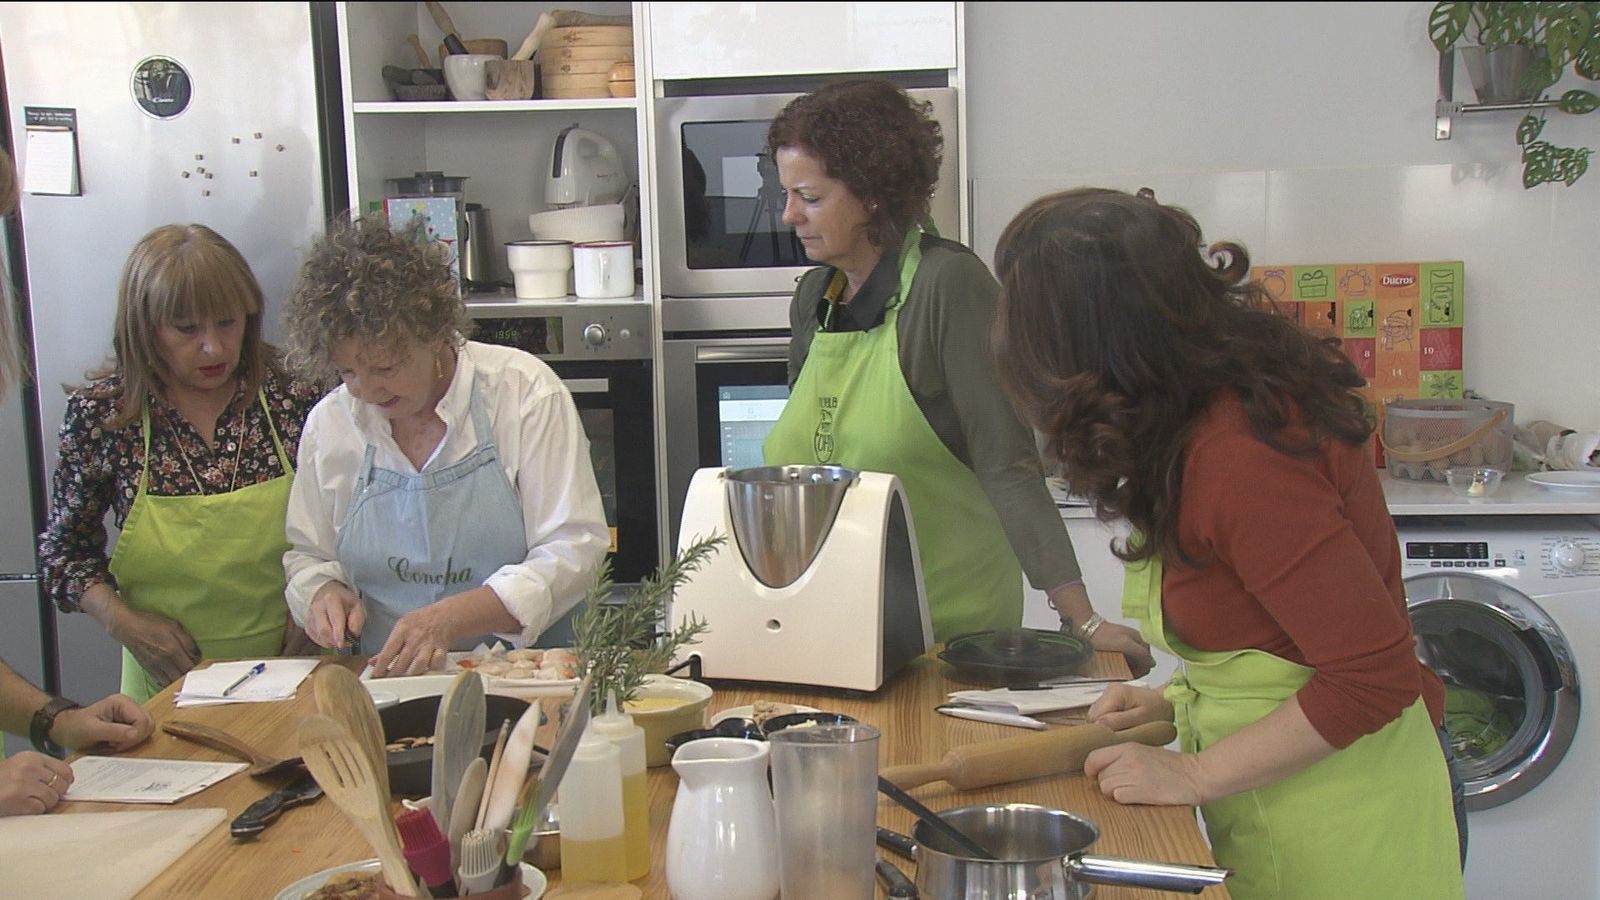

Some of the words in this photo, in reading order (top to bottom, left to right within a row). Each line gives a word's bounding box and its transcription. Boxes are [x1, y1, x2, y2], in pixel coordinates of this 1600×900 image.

[1382, 276, 1414, 286] Ducros
[1364, 350, 1370, 358] 8
[1423, 347, 1434, 355] 10
[1392, 368, 1402, 377] 14
[387, 556, 473, 586] Concha
